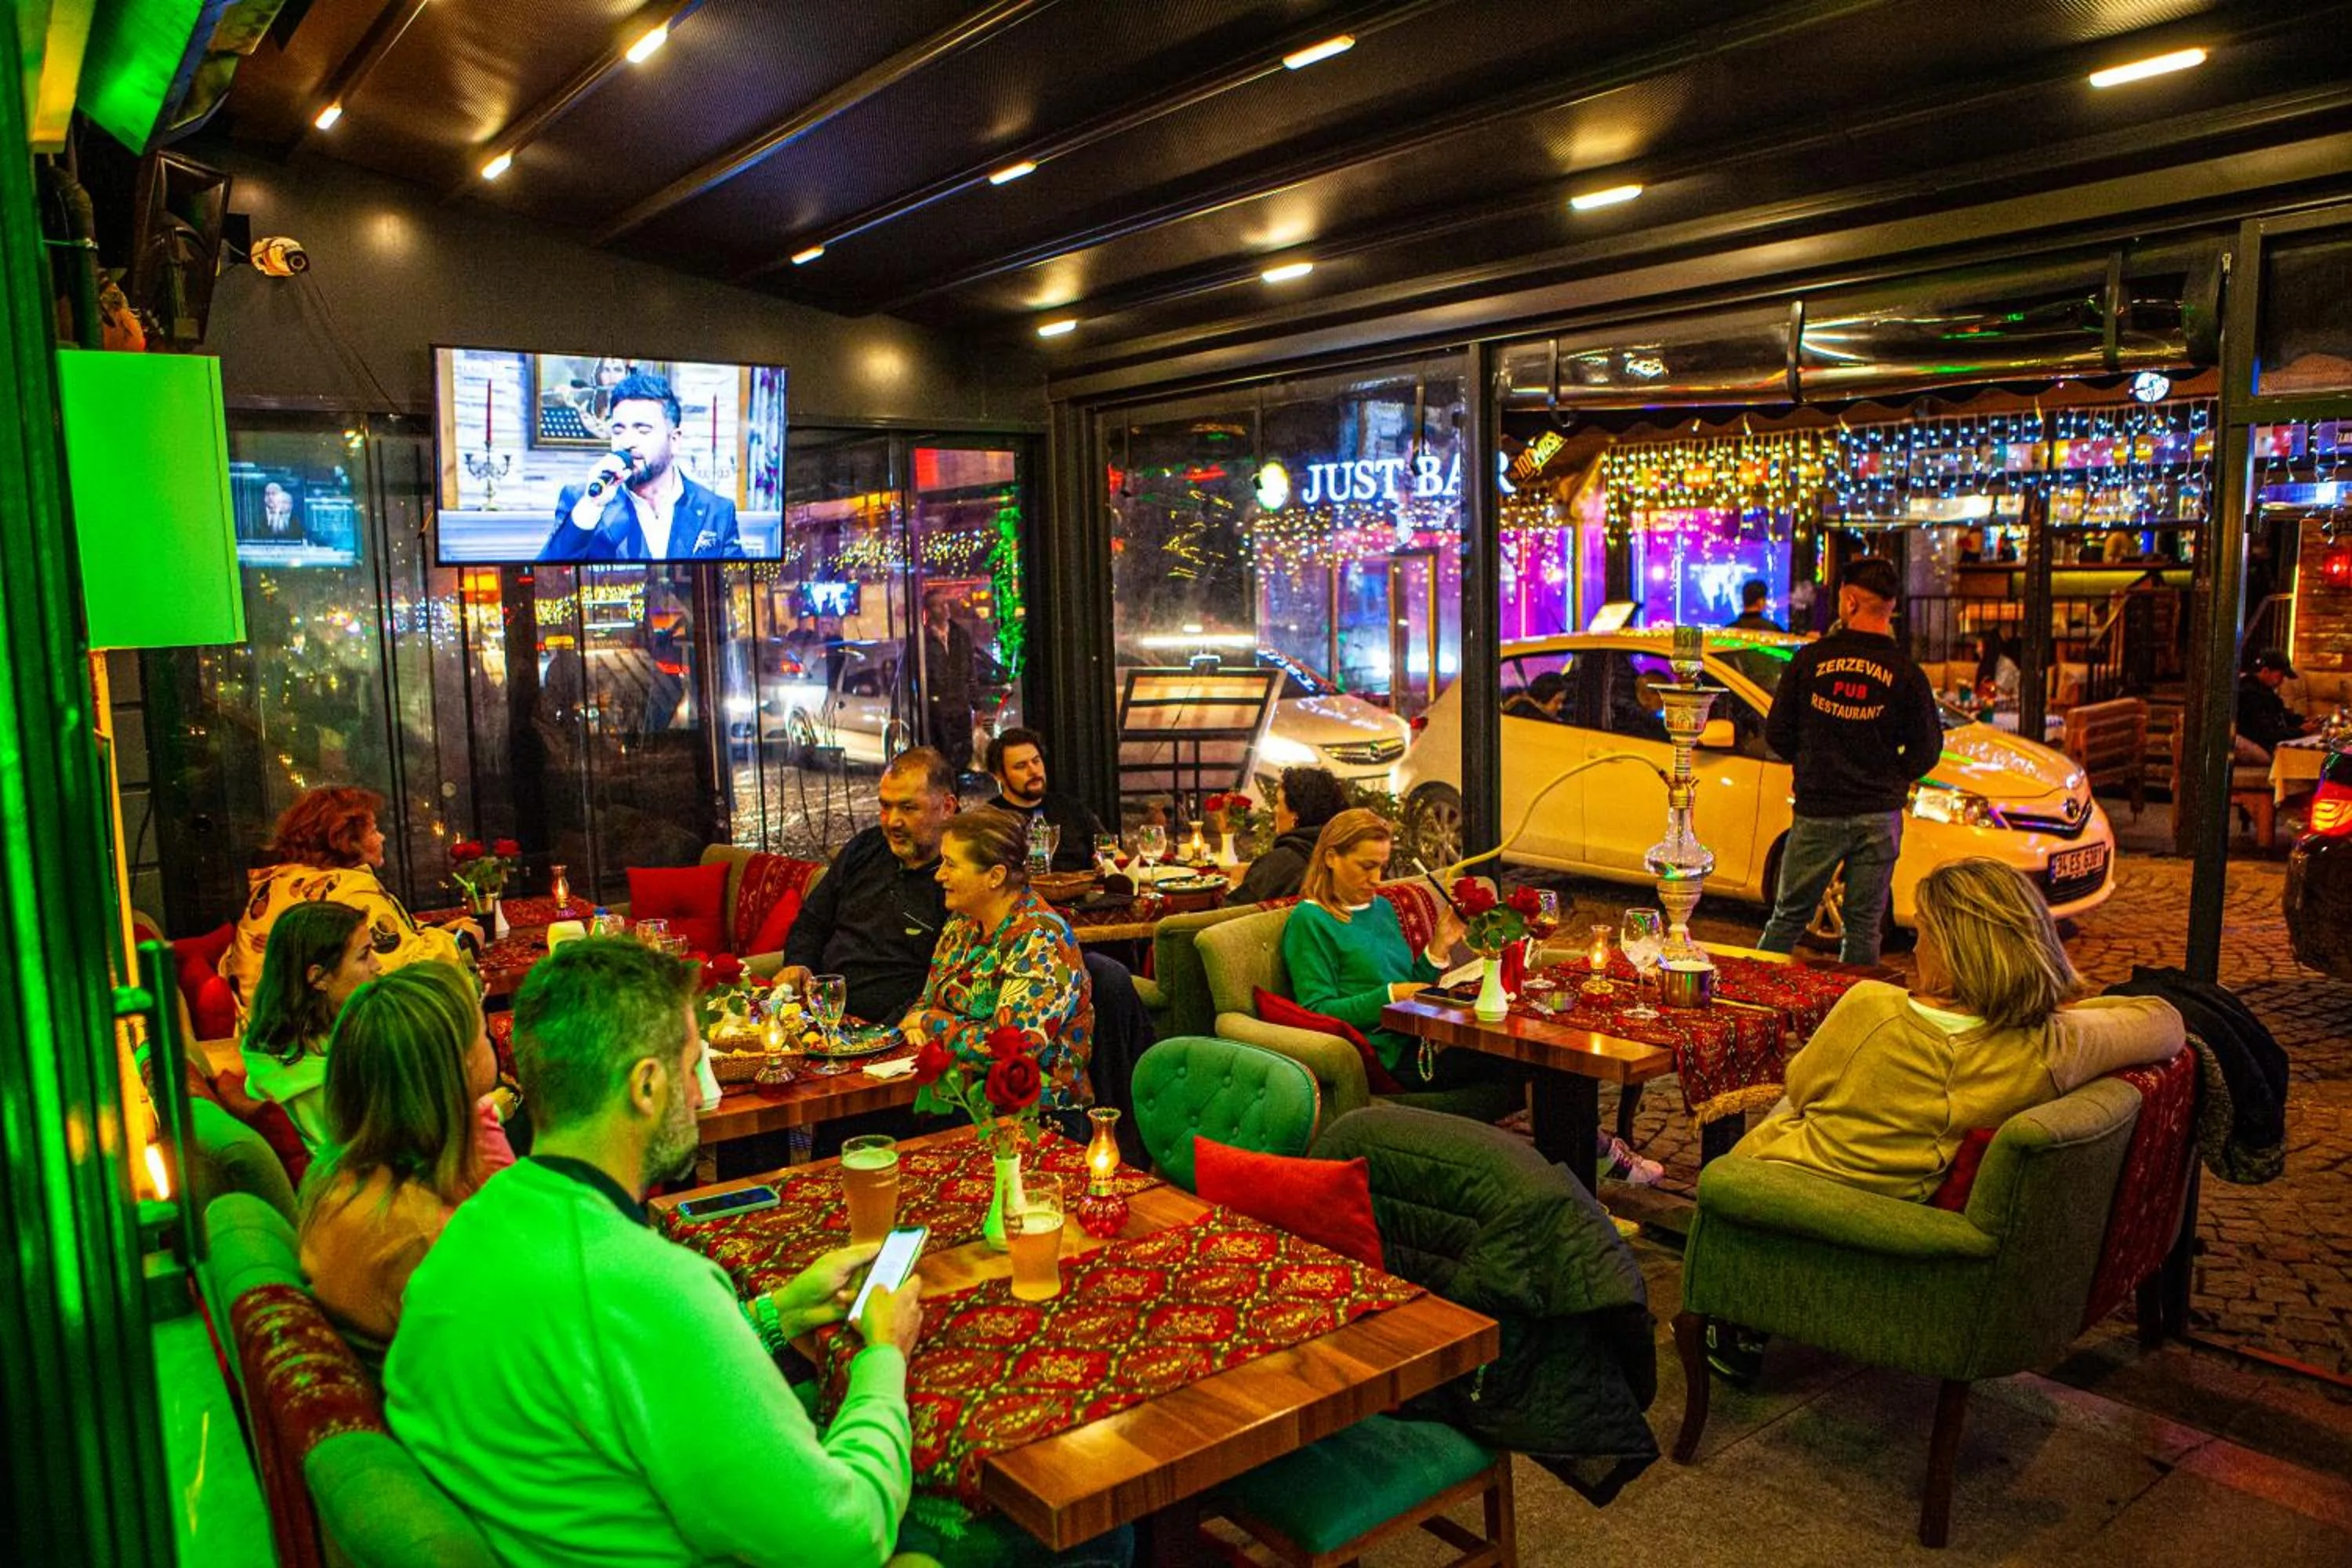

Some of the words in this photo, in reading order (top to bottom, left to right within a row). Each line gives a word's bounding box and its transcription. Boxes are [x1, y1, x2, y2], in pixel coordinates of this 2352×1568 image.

[1302, 458, 1405, 503] JUST
[1816, 657, 1893, 688] ZERZEVAN
[1833, 681, 1867, 699] PUB
[1811, 691, 1885, 720] RESTAURANT
[2056, 855, 2067, 876] 34
[2070, 851, 2081, 873] ES
